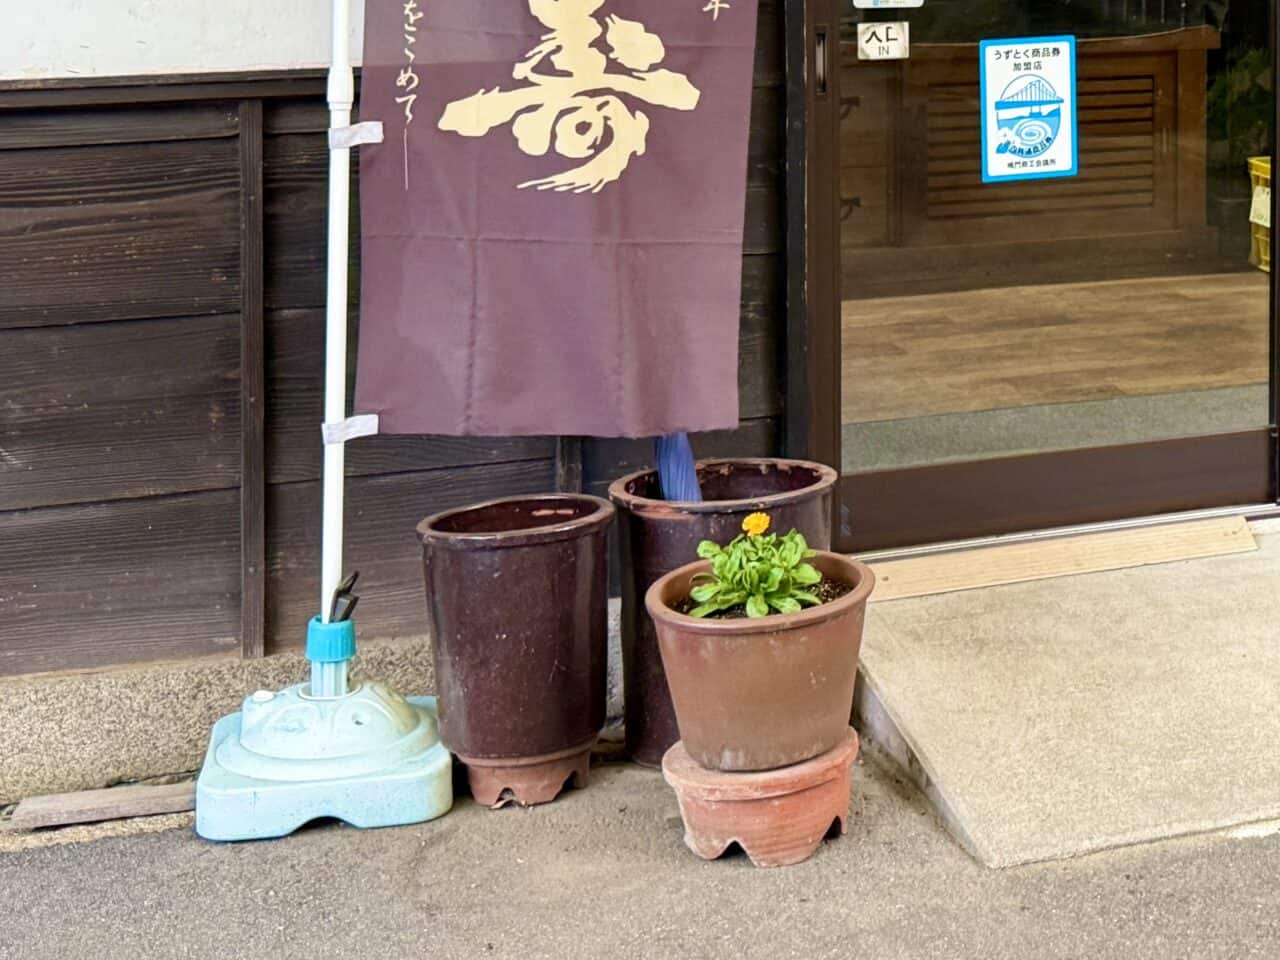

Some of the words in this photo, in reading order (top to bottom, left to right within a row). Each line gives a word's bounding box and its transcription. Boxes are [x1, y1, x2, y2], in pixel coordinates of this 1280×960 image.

[878, 46, 890, 56] IN
[994, 47, 1061, 60] うずとく商品券
[1013, 61, 1042, 72] 加盟店
